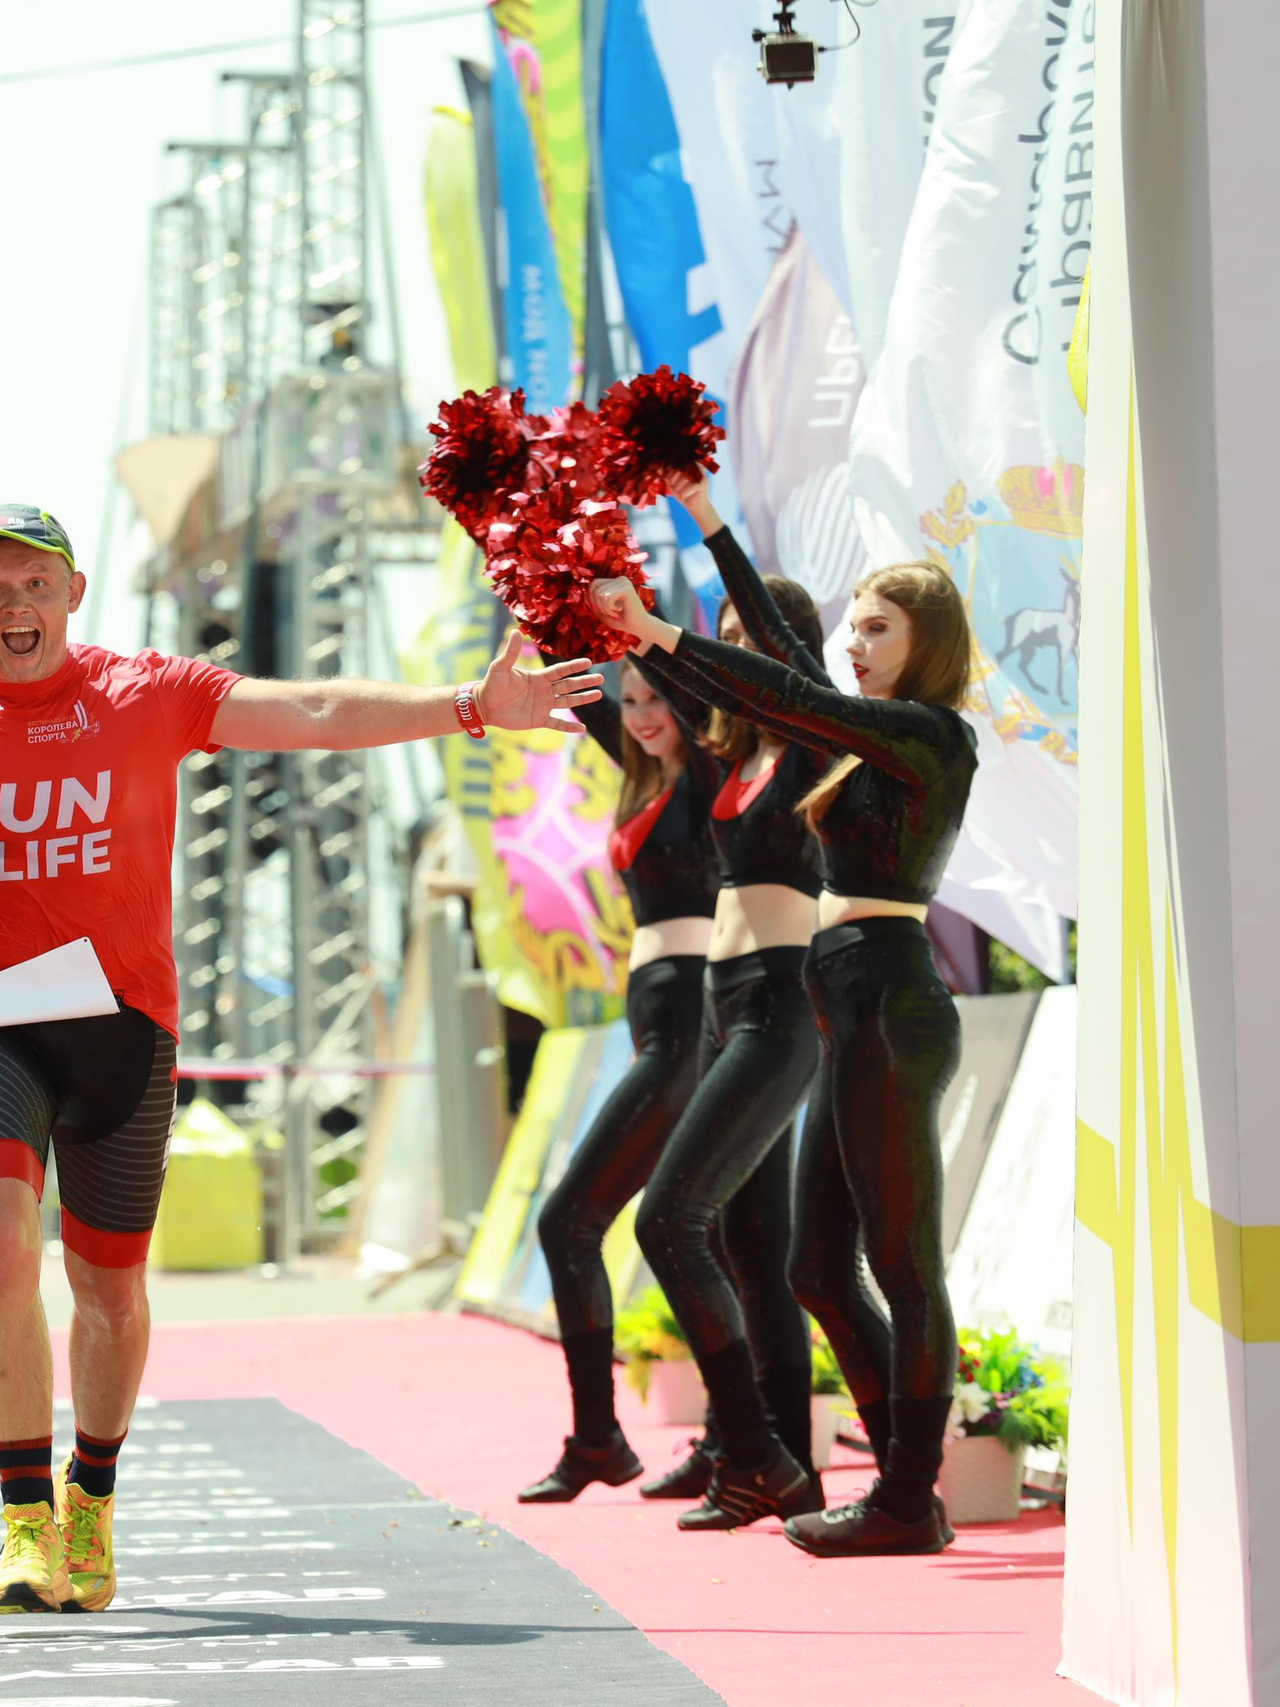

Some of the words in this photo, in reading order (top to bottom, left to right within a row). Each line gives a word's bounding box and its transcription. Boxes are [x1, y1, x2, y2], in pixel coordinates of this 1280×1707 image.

[27, 720, 79, 735] КОРОЛЕВА
[27, 731, 67, 744] СПОРТА
[70, 1656, 445, 1672] STAR
